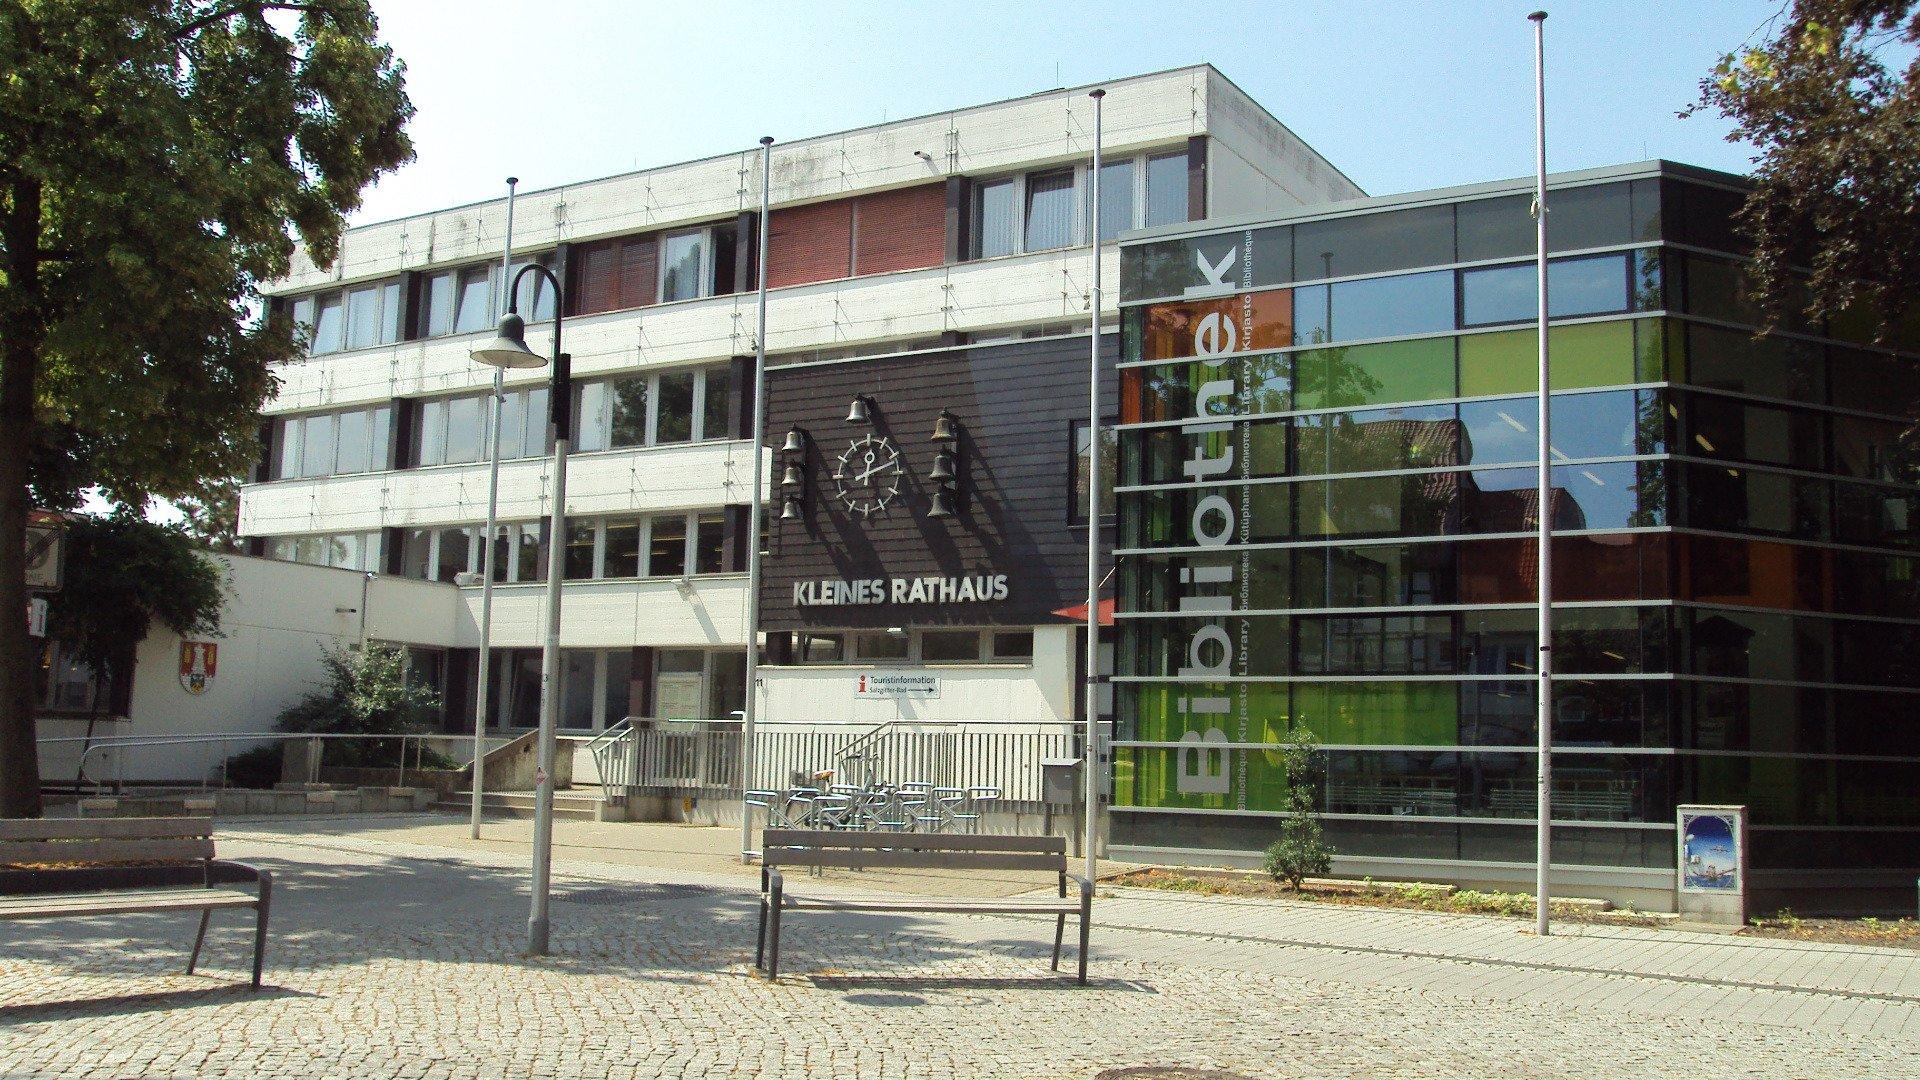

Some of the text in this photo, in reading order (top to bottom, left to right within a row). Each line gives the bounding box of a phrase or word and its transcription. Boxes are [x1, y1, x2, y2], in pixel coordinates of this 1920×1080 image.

[1243, 230, 1254, 288] Bibliothèque
[1243, 295, 1253, 351] Kirjasto
[1242, 360, 1253, 415] Library
[1177, 246, 1237, 794] Bibliothek
[1241, 484, 1251, 545] Kütüphane
[793, 574, 1009, 606] KLEINES RATHAUS
[1239, 619, 1250, 676] Library
[870, 675, 936, 684] Touristinformation
[1238, 684, 1249, 743] Kirjasto
